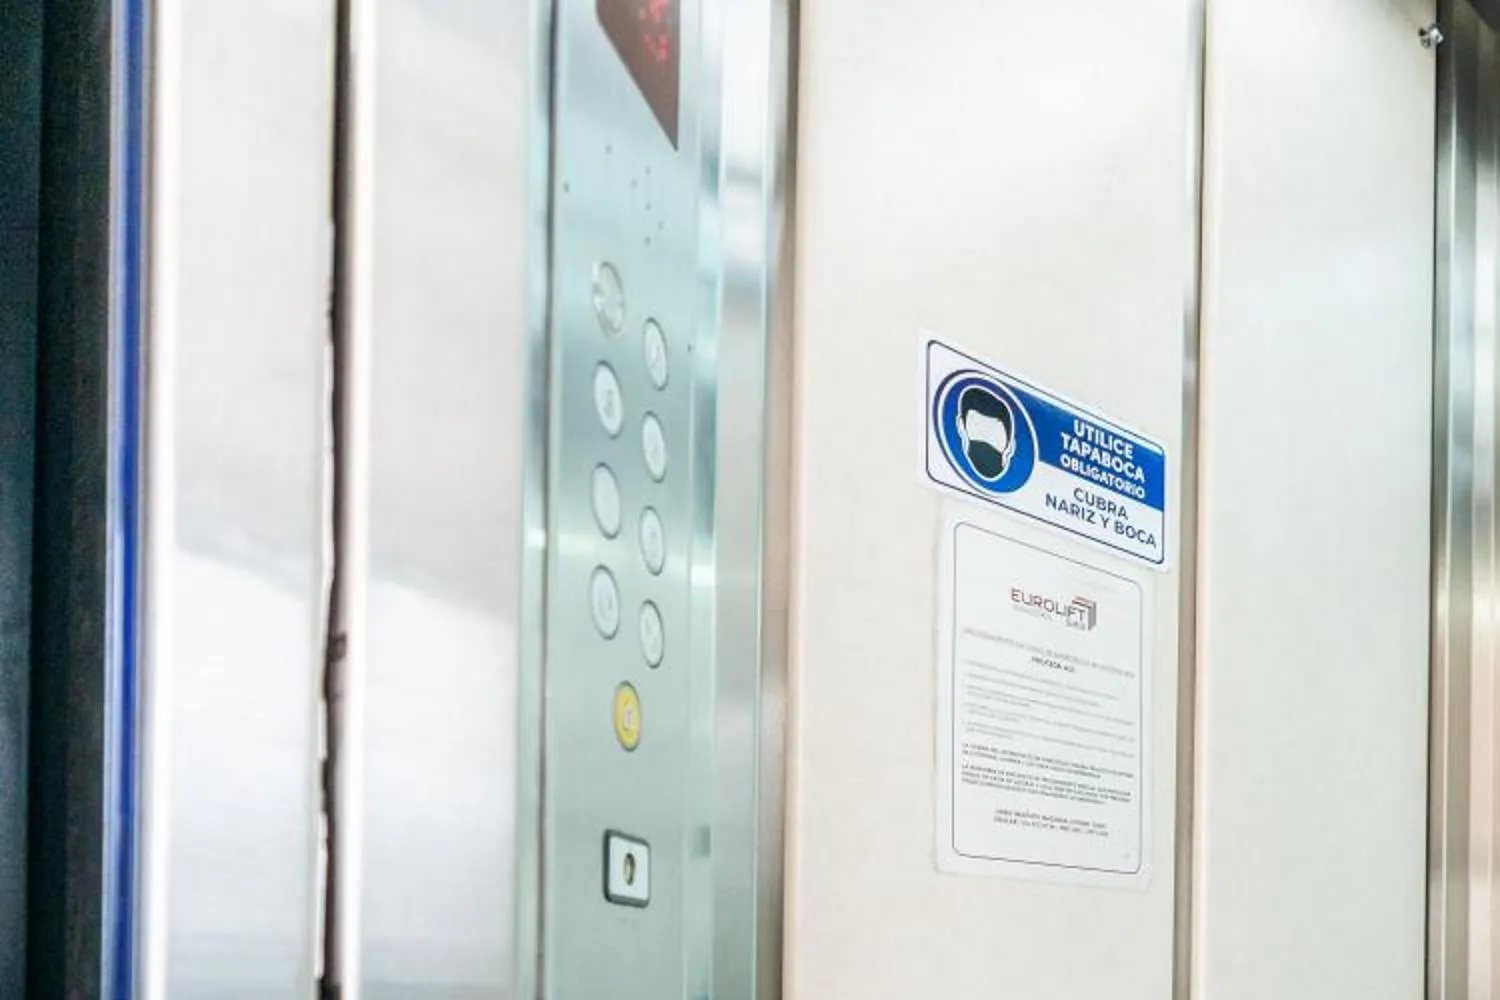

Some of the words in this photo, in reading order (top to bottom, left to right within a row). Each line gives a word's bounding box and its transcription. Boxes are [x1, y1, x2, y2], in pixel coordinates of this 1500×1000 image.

[1061, 432, 1145, 484] TAPABOCA
[1073, 419, 1134, 460] UTILICE
[1060, 454, 1145, 499] OBLIGATORIO
[1045, 493, 1096, 525] NARIZ
[1100, 514, 1110, 529] Y
[1114, 520, 1157, 549] BOCA
[1073, 487, 1129, 520] CUBRA
[1011, 587, 1086, 622] EUROLIFT
